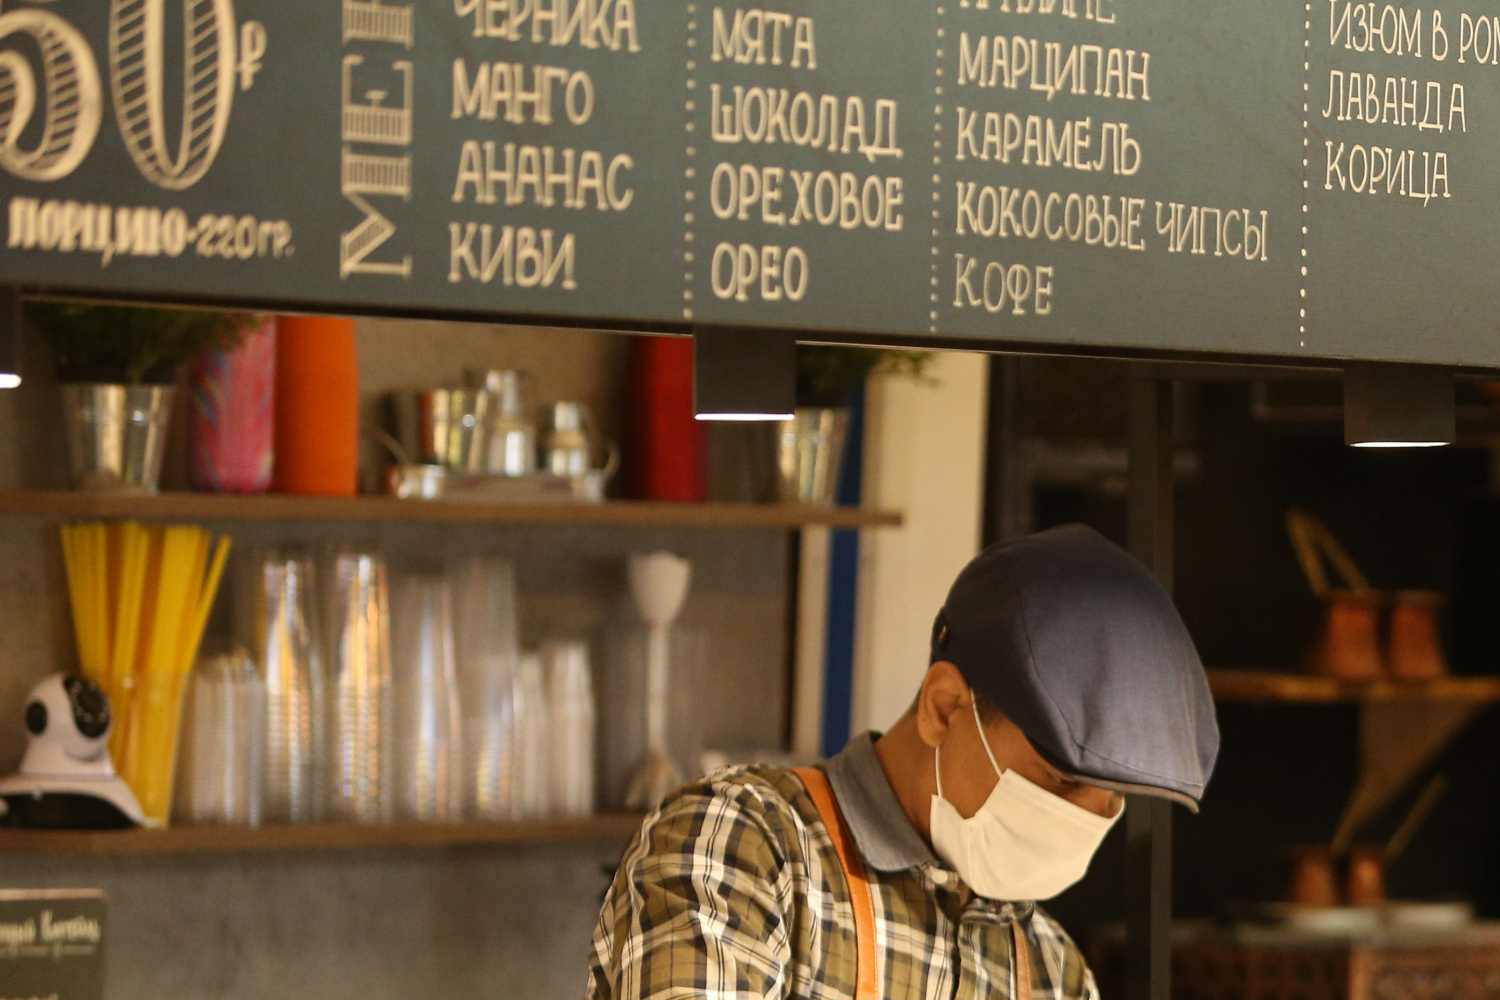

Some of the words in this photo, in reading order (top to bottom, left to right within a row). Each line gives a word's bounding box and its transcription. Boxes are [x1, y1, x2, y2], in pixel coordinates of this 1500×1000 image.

[453, 0, 642, 52] ЧЕРНИКА
[711, 7, 817, 69] МЯТА
[1330, 0, 1422, 57] ИЗЮМ
[1432, 9, 1449, 62] В
[450, 57, 595, 126] МАНГО
[957, 32, 1150, 101] МАРЦИПАН
[1323, 69, 1466, 133] ЛАВАНДА
[711, 84, 903, 162] ШОКОЛАД
[956, 106, 1141, 175] КАРАМЕЛЬ
[453, 139, 634, 212] АНАНАС
[711, 163, 903, 232] ОРЕХОВОЕ
[1325, 140, 1451, 207] КОРИЦА
[447, 221, 578, 290] КИВИ
[955, 181, 1146, 252] КОКОСОВЫЕ
[1155, 200, 1268, 262] ЧИПСЫ
[711, 242, 808, 301] ОРЕО
[953, 253, 1055, 315] КОФЕ
